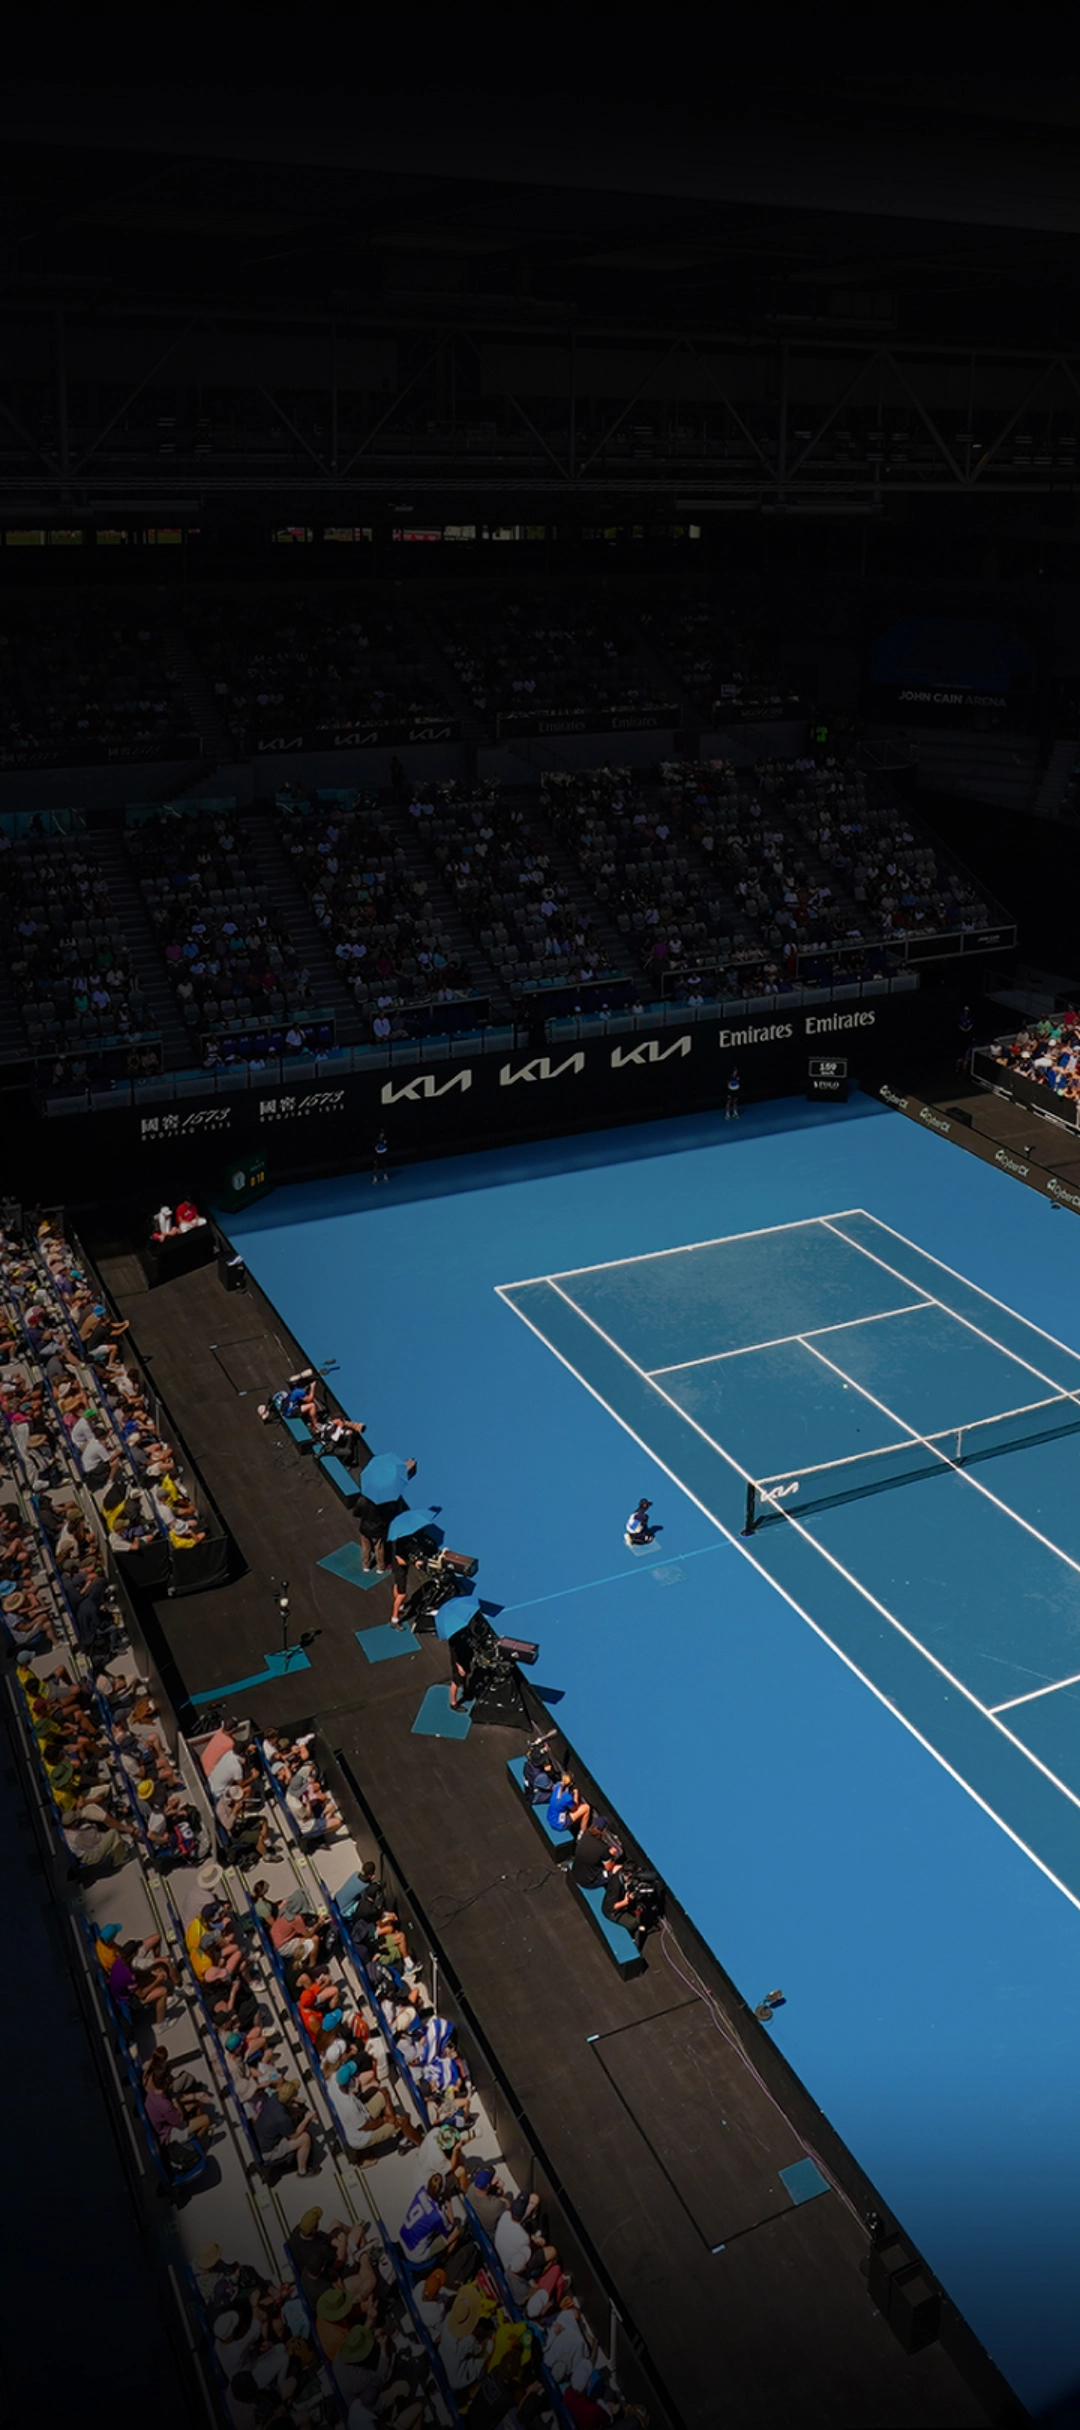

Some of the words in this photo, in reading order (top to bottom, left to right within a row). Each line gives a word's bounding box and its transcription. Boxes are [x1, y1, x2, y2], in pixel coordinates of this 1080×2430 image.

[899, 691, 930, 702] JOHN
[933, 692, 963, 705] CAIN
[965, 695, 1007, 708] ARENA
[538, 720, 586, 733] Emirates
[612, 716, 657, 729] Emirates
[257, 736, 303, 750] KIA
[334, 732, 378, 746] KIA
[409, 727, 451, 741] KIA
[805, 1010, 876, 1035] Emirates
[718, 1022, 794, 1048] Emirates
[610, 1035, 692, 1069] KIA
[499, 1051, 585, 1086] KIA
[380, 1069, 472, 1105] KIA
[760, 1481, 799, 1502] KIA
